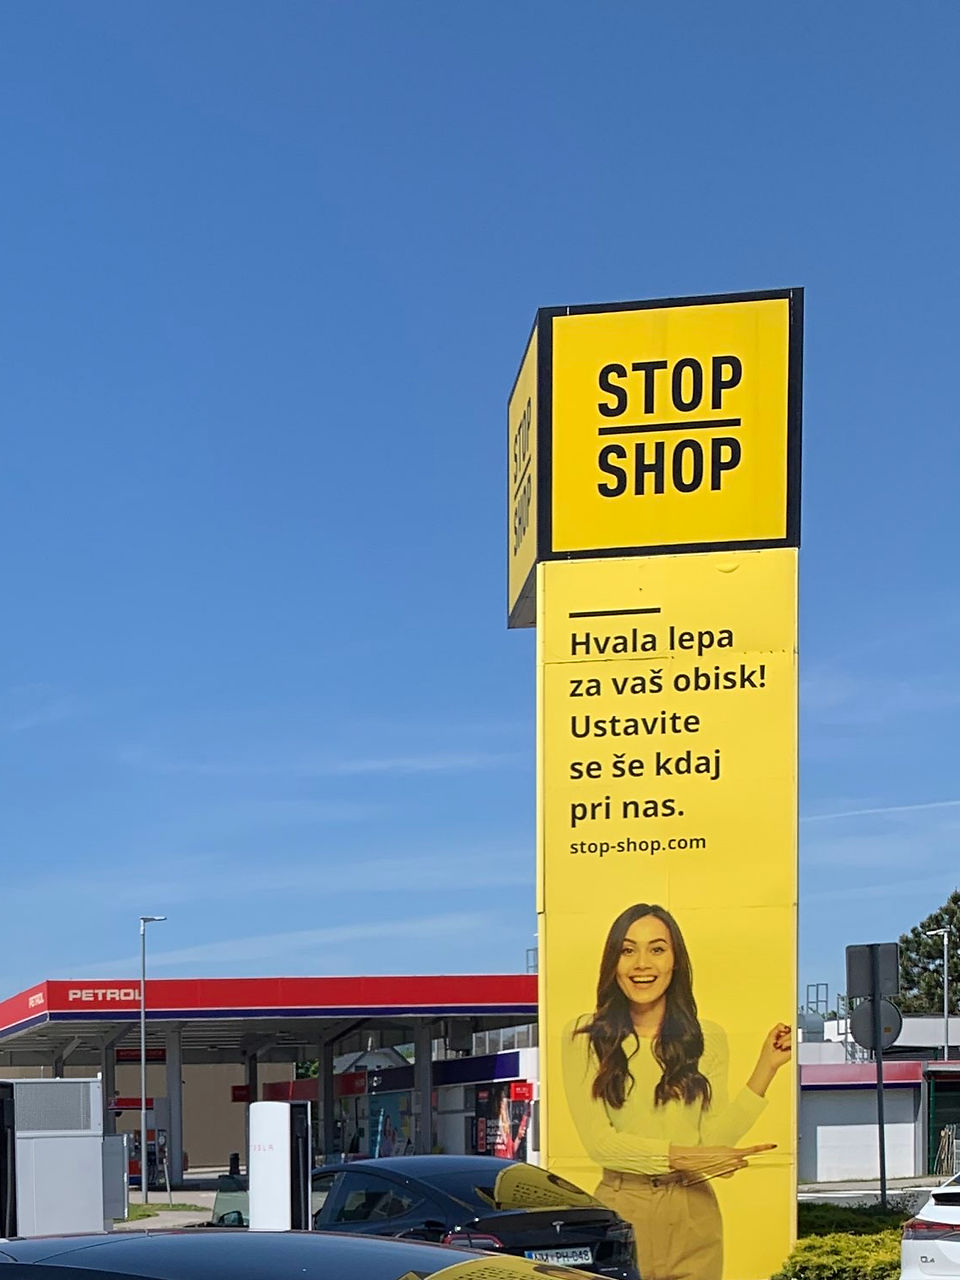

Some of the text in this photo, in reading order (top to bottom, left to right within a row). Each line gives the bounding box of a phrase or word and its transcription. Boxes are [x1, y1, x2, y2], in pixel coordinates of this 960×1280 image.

[597, 355, 742, 418] STOP
[597, 437, 742, 498] SHOP
[571, 626, 734, 656] Hvala lepa
[569, 664, 766, 697] za vaš obisk!
[571, 711, 700, 738] Ustavite
[570, 749, 721, 780] se še kdaj
[570, 796, 684, 828] pri nas.
[570, 837, 706, 858] stop-shop.com
[68, 989, 142, 1001] PETROL
